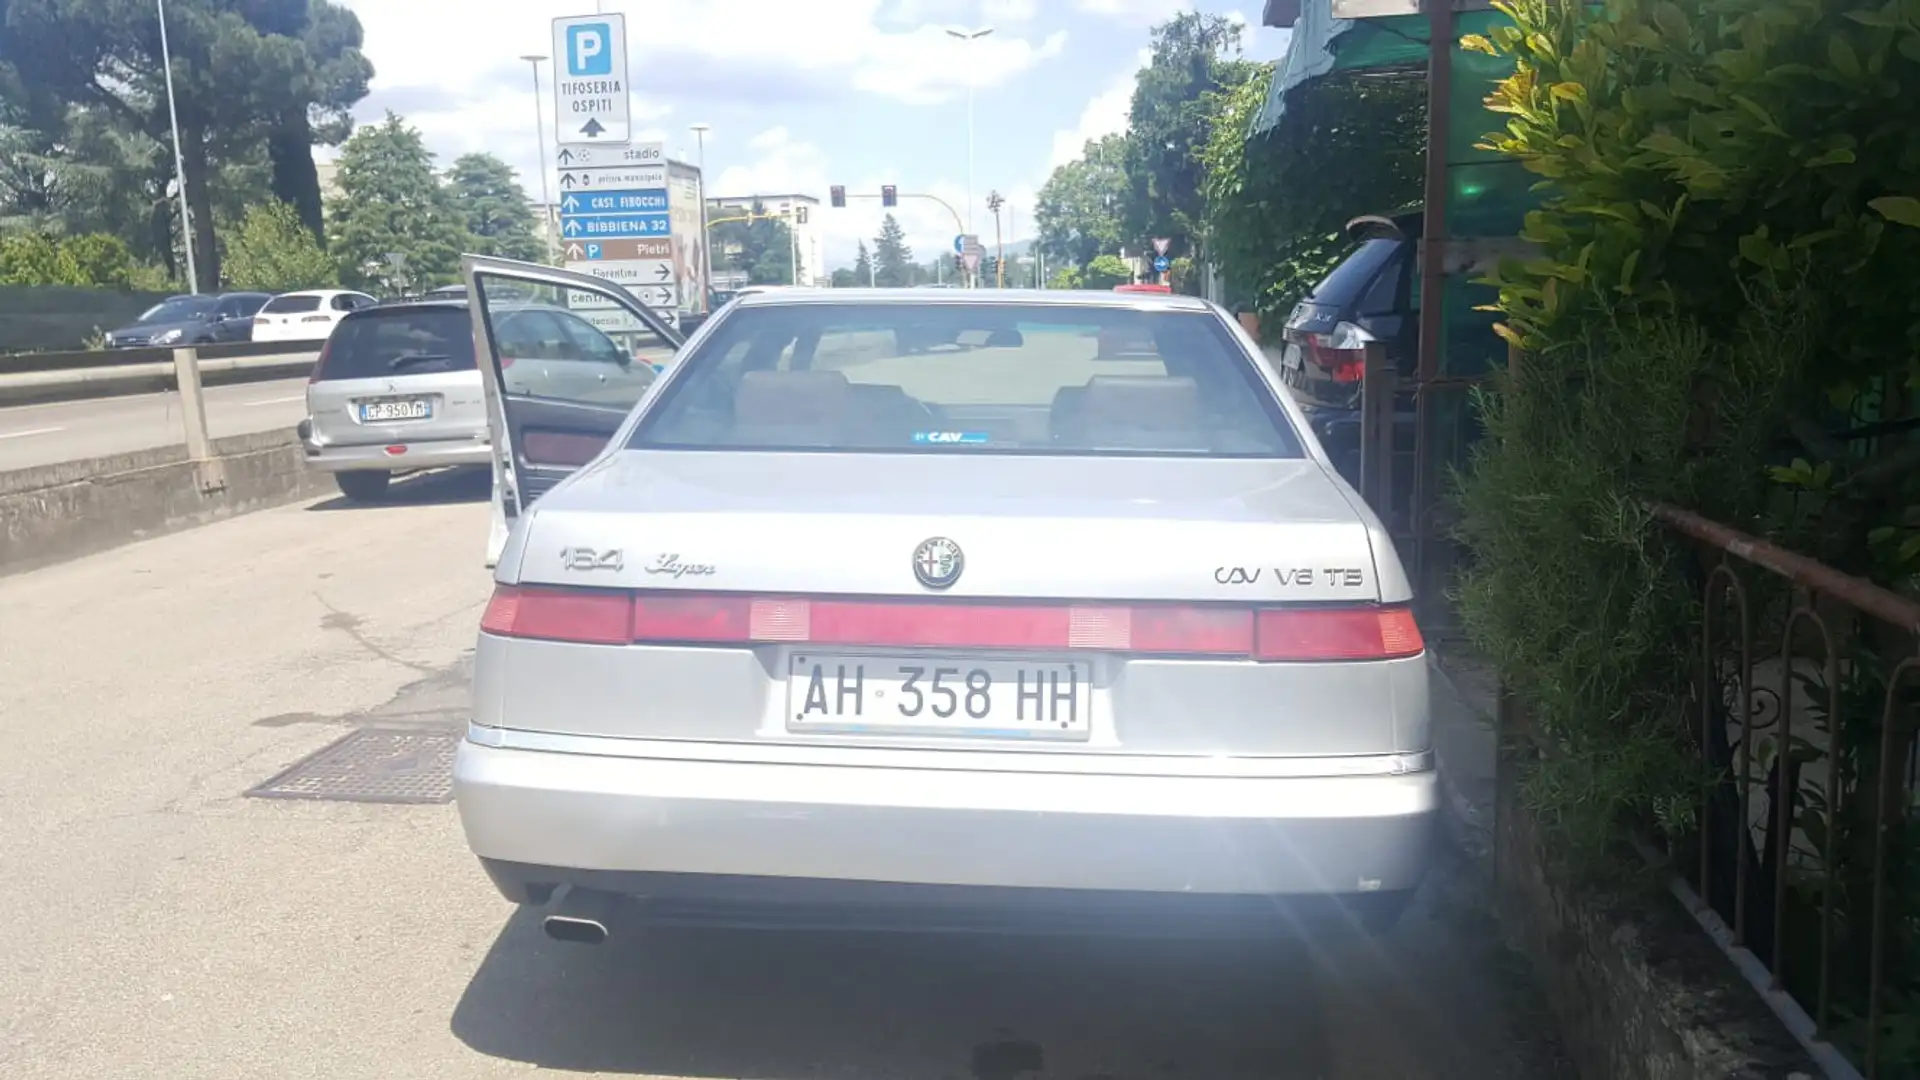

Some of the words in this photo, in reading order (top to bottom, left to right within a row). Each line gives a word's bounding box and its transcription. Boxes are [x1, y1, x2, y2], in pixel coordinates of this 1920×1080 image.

[575, 30, 603, 70] P
[561, 80, 622, 95] TIFOSERIA
[572, 98, 613, 113] OSPITI
[623, 147, 660, 160] stadio
[586, 221, 648, 233] BIBBIENA
[650, 219, 667, 231] 32
[636, 243, 670, 255] Pietri
[592, 267, 638, 279] Fiorentina
[928, 432, 963, 442] CAV
[559, 548, 624, 572] 164
[1274, 567, 1313, 586] V6
[1323, 568, 1363, 586] TB
[803, 663, 864, 716] AH
[897, 666, 992, 719] 358
[1016, 669, 1078, 722] HH
